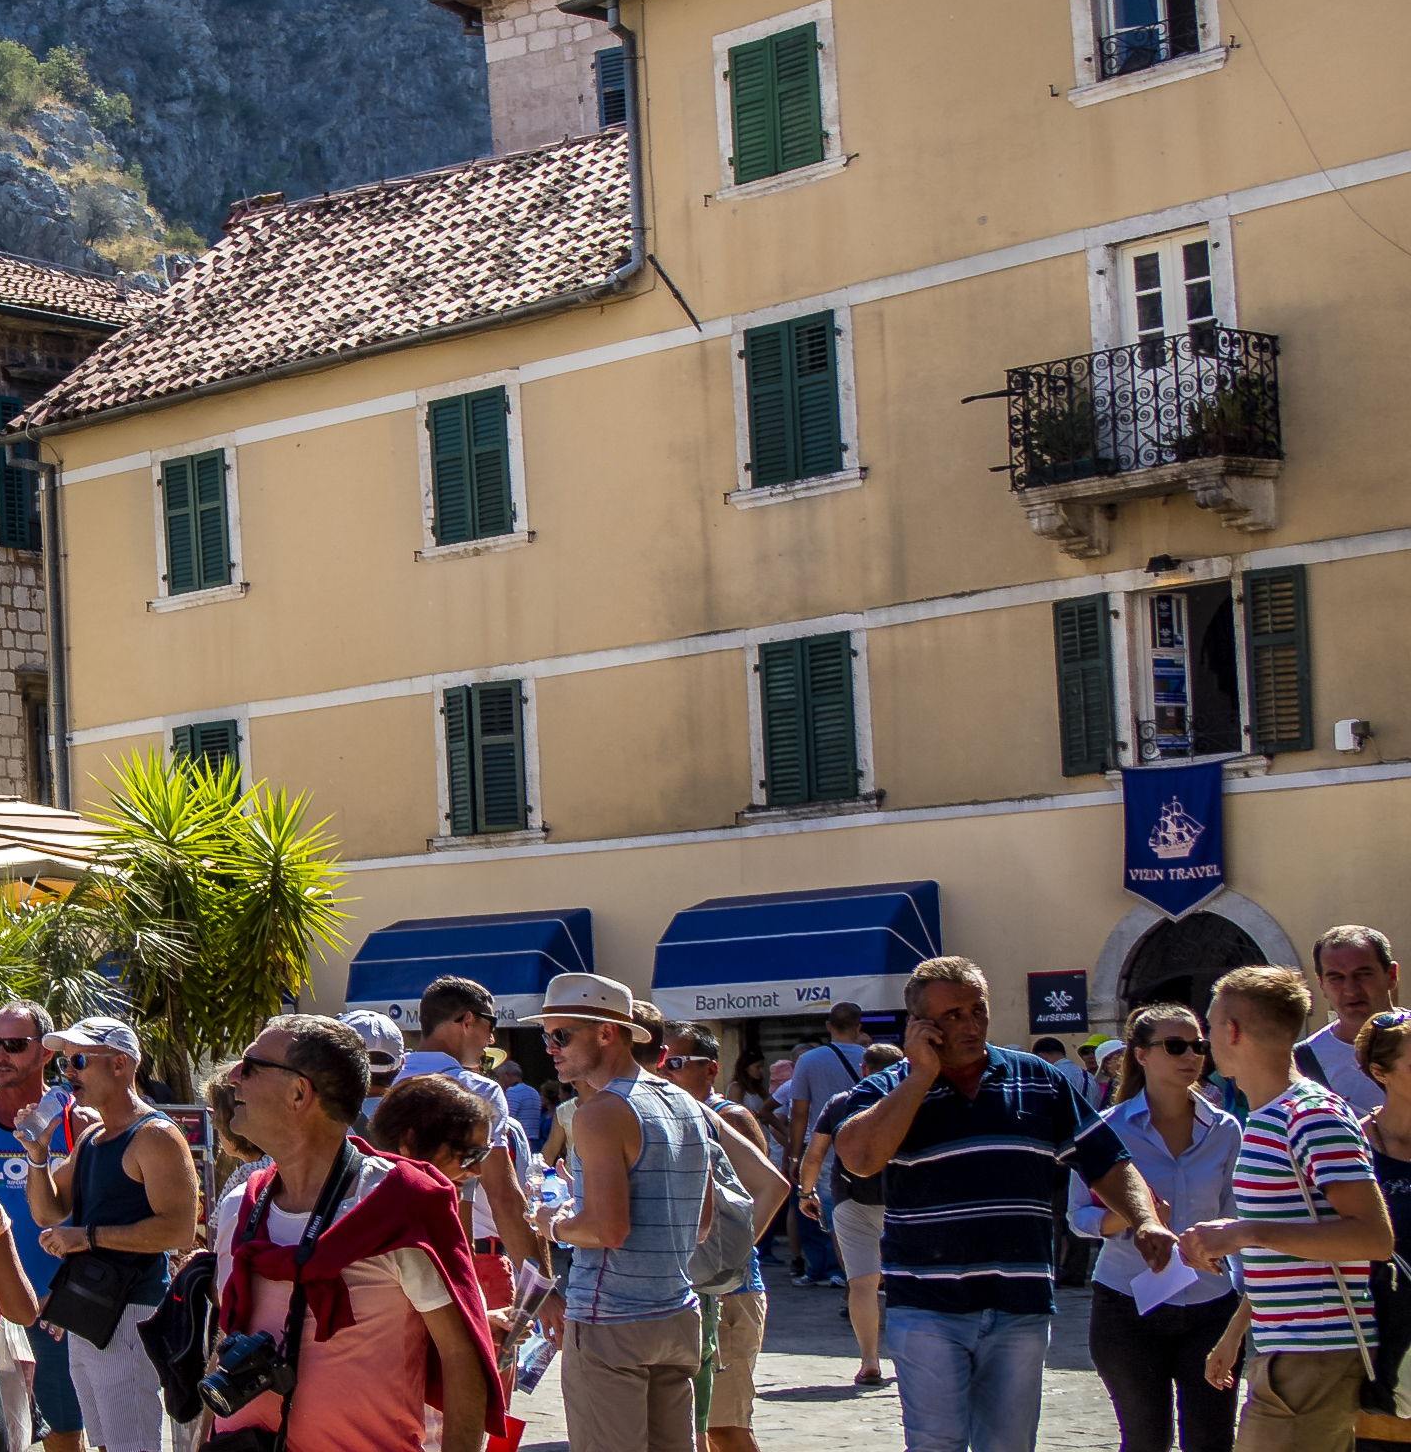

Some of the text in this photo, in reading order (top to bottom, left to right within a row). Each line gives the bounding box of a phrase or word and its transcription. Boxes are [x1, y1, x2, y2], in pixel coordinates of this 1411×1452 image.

[1168, 864, 1221, 880] TRAVEL
[695, 987, 830, 1011] Bankomat VISA
[1036, 1012, 1081, 1022] AirSERBIA
[306, 1215, 322, 1238] Nikon
